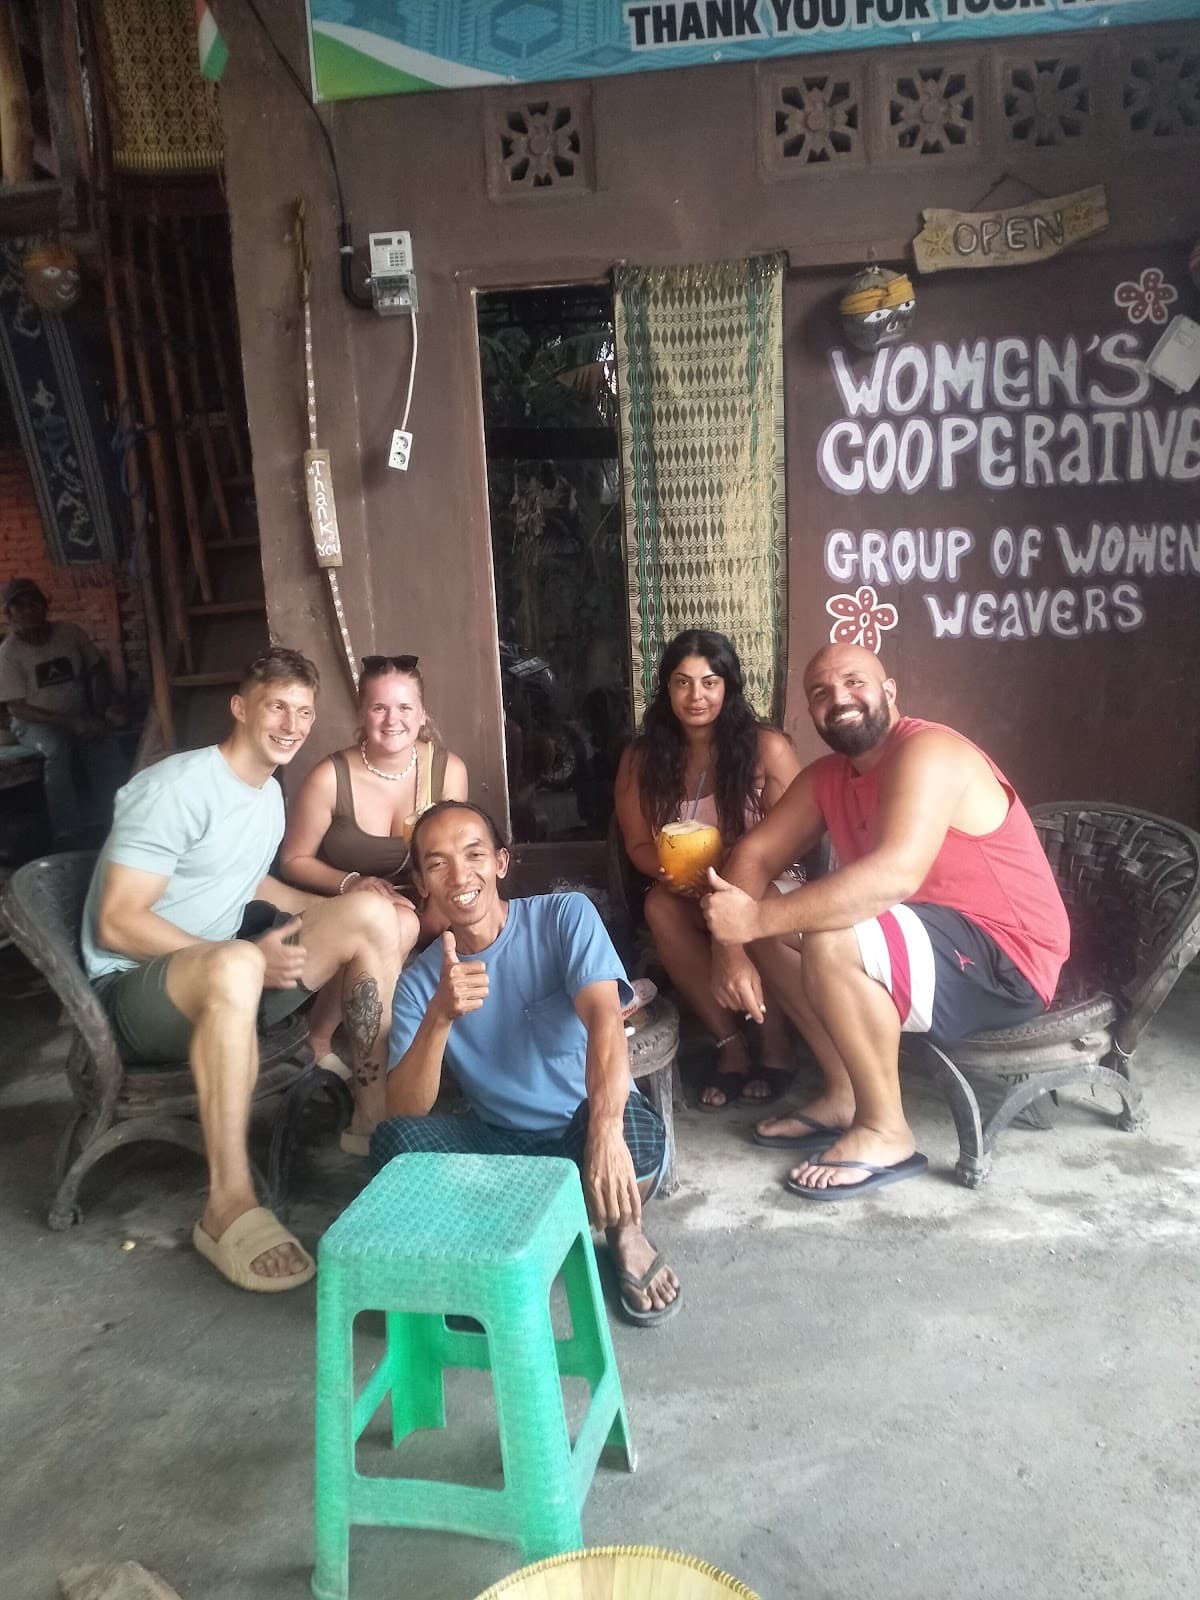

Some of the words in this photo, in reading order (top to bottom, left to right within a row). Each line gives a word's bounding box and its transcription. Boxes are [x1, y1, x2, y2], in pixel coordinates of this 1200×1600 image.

[628, 0, 761, 45] THANK
[773, 0, 846, 32] YOU
[953, 211, 1064, 256] OPEN
[830, 333, 1150, 416] WOMEN'S
[827, 530, 972, 583] GROUP
[992, 528, 1042, 577] OF
[1056, 524, 1200, 575] WOMEN
